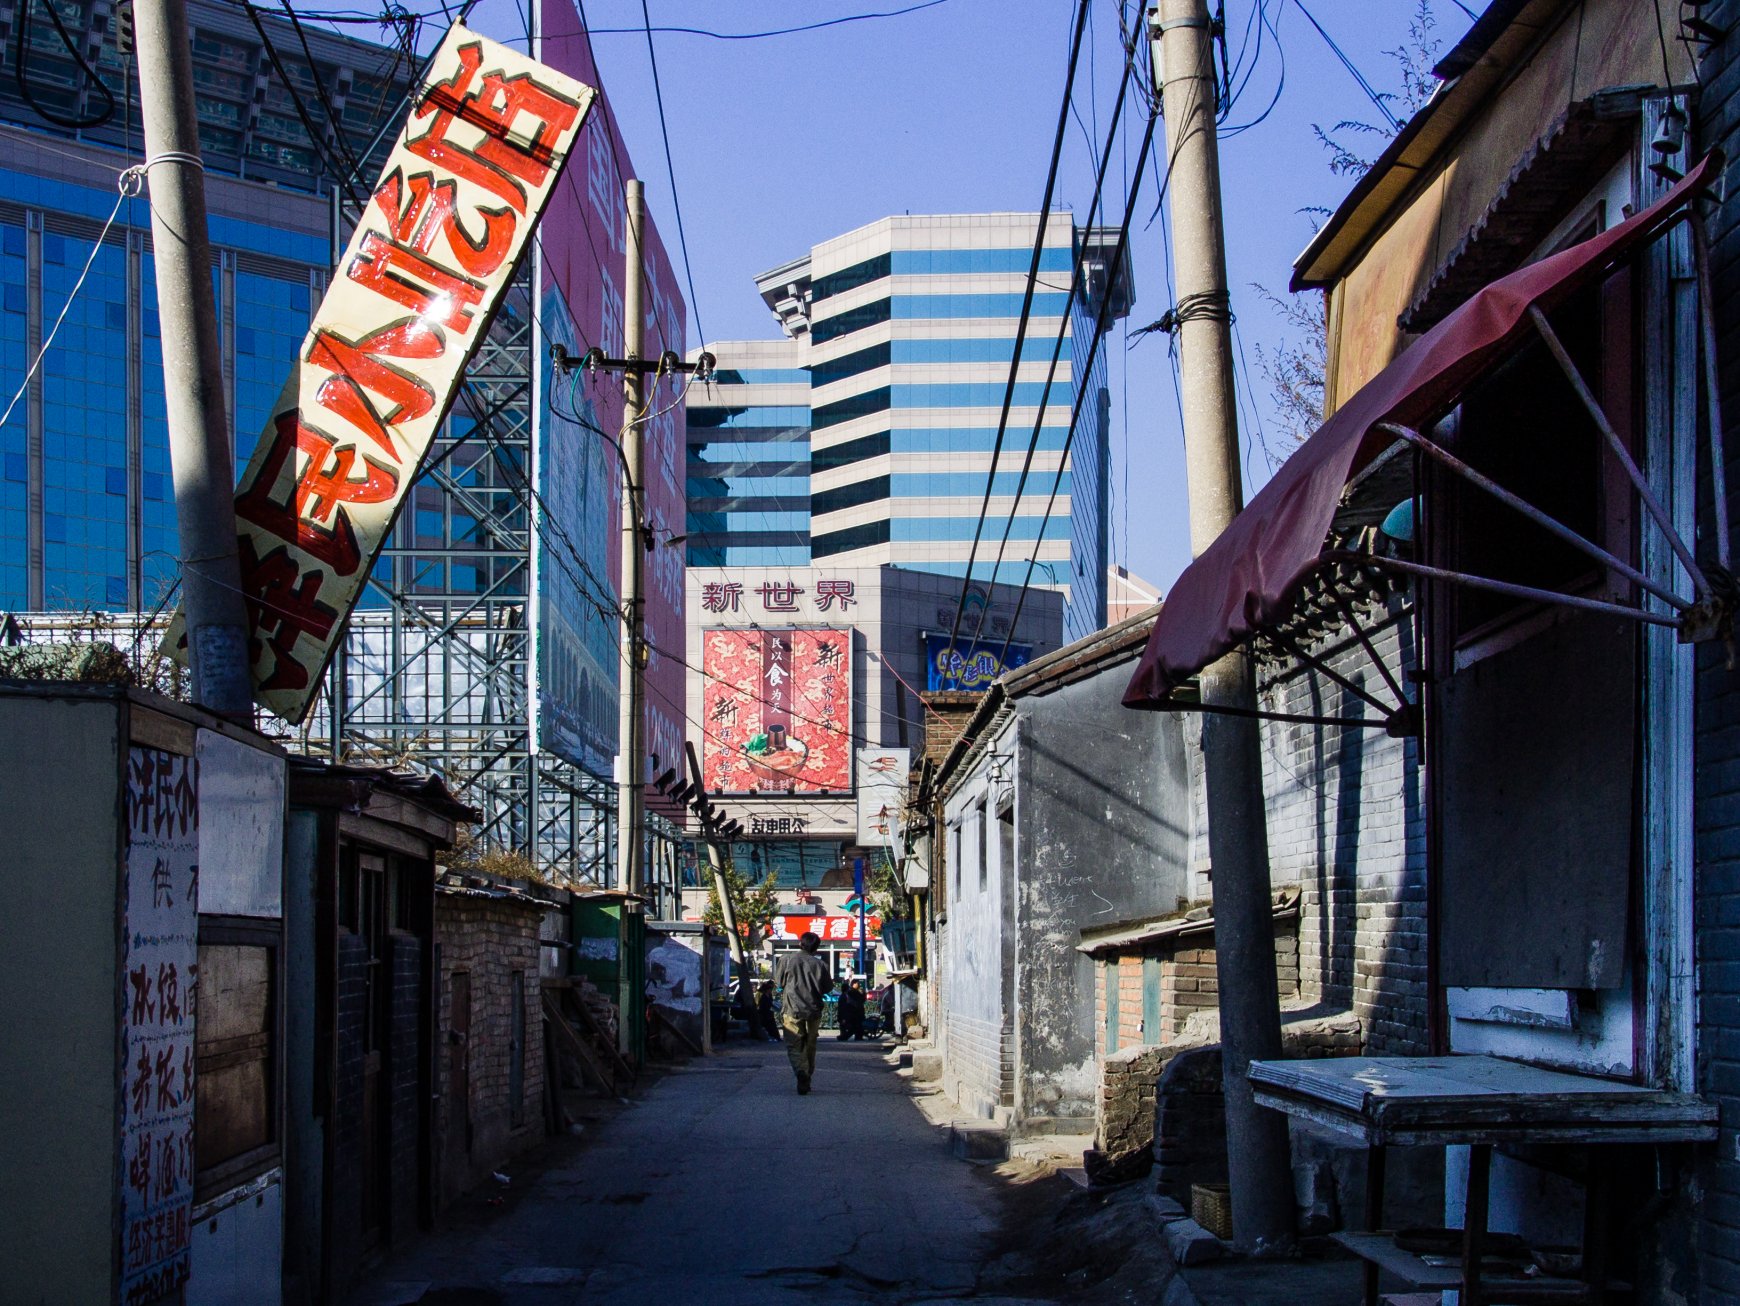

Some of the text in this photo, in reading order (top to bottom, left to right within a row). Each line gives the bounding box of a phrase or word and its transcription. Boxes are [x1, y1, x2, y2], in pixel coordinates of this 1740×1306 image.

[702, 580, 857, 612] 新世界
[764, 637, 789, 714] 民以食为天
[809, 918, 871, 938] 肯德基
